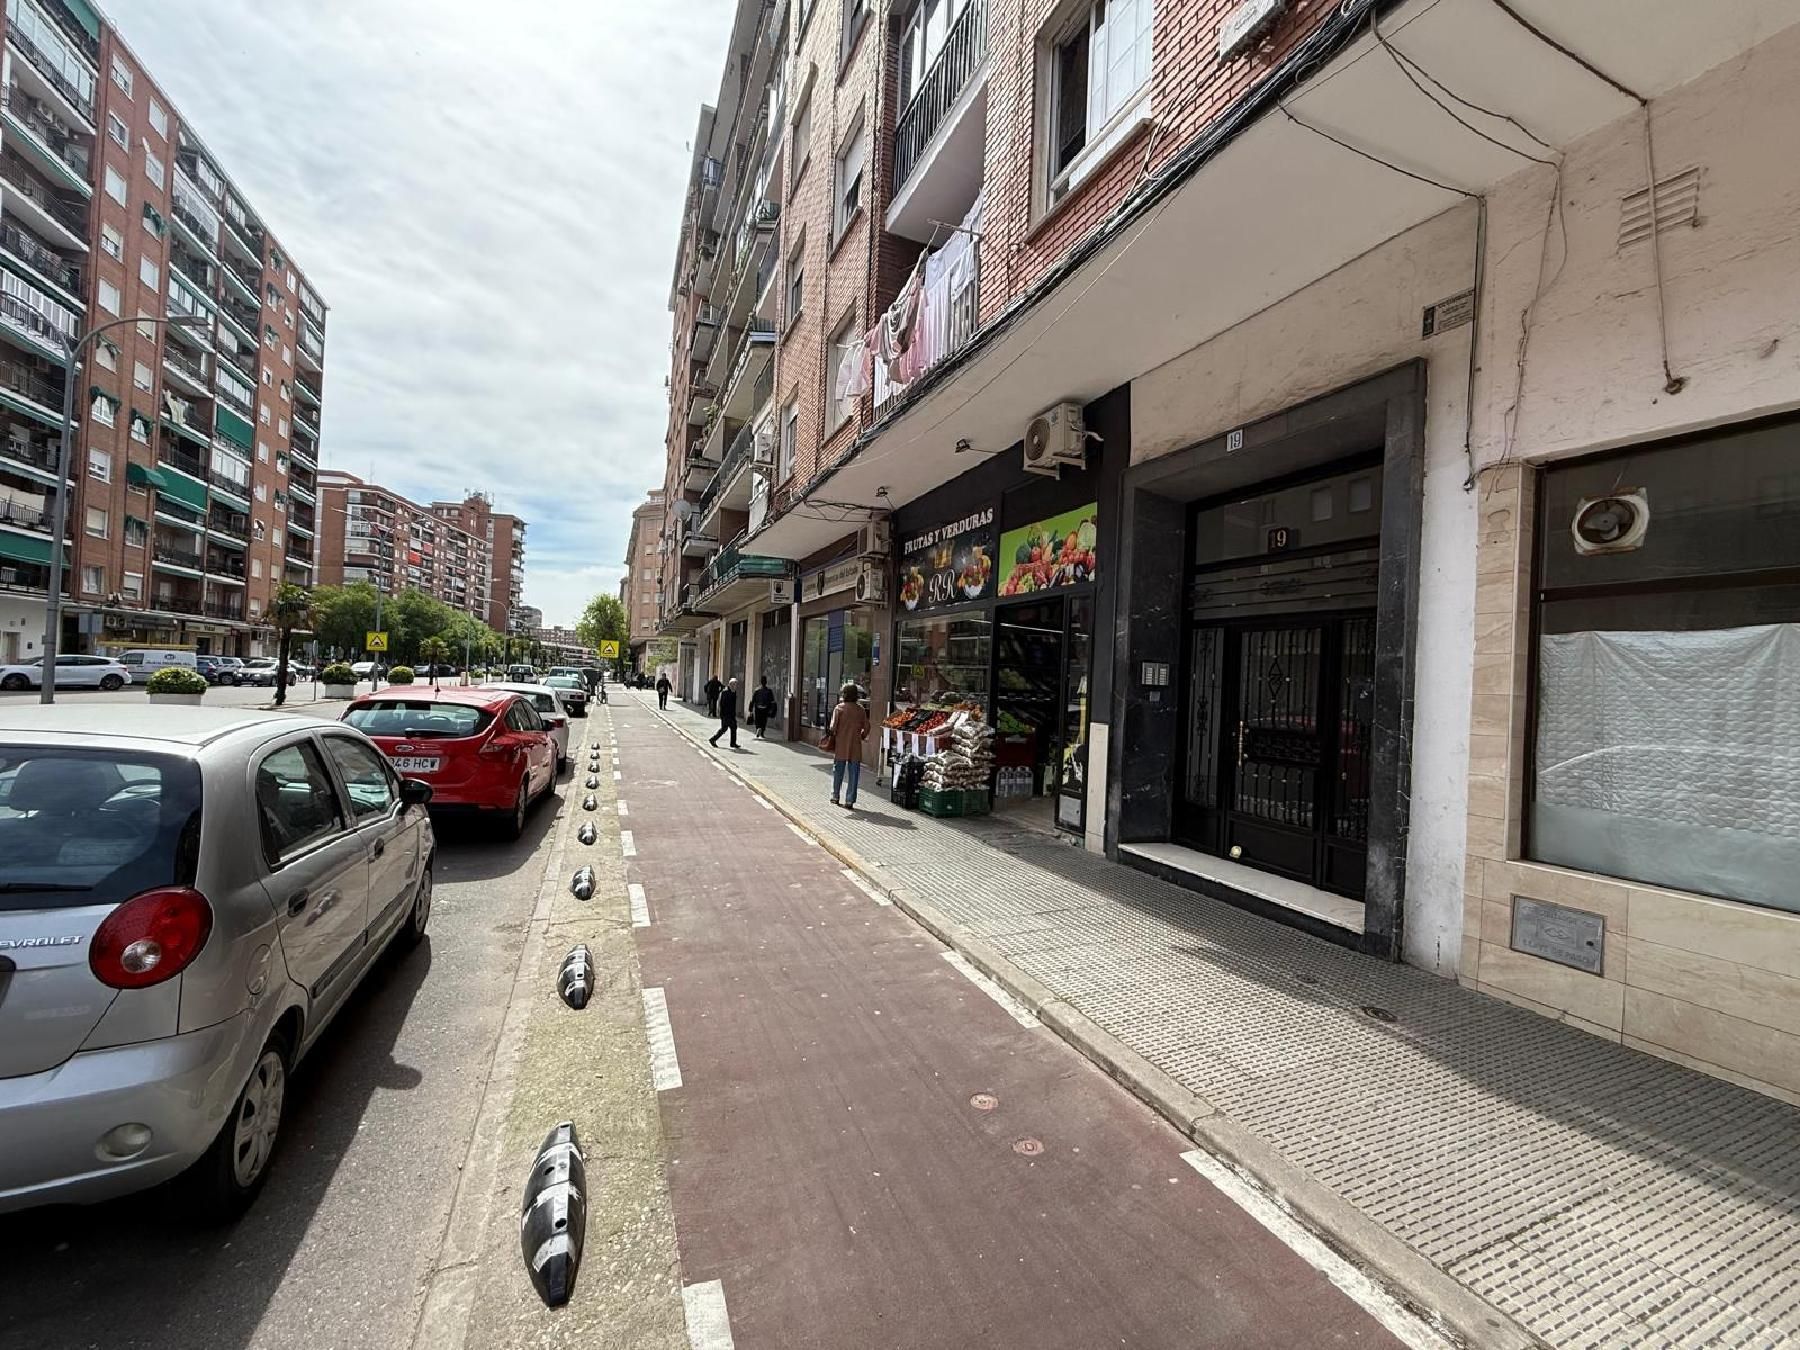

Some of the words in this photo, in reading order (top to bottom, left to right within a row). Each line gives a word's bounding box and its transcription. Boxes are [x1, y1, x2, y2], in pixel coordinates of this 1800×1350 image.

[1230, 431, 1241, 450] 19
[904, 532, 934, 555] FRUTAS
[934, 529, 941, 543] Y
[942, 507, 993, 539] VERDURAS
[1271, 530, 1287, 549] 19
